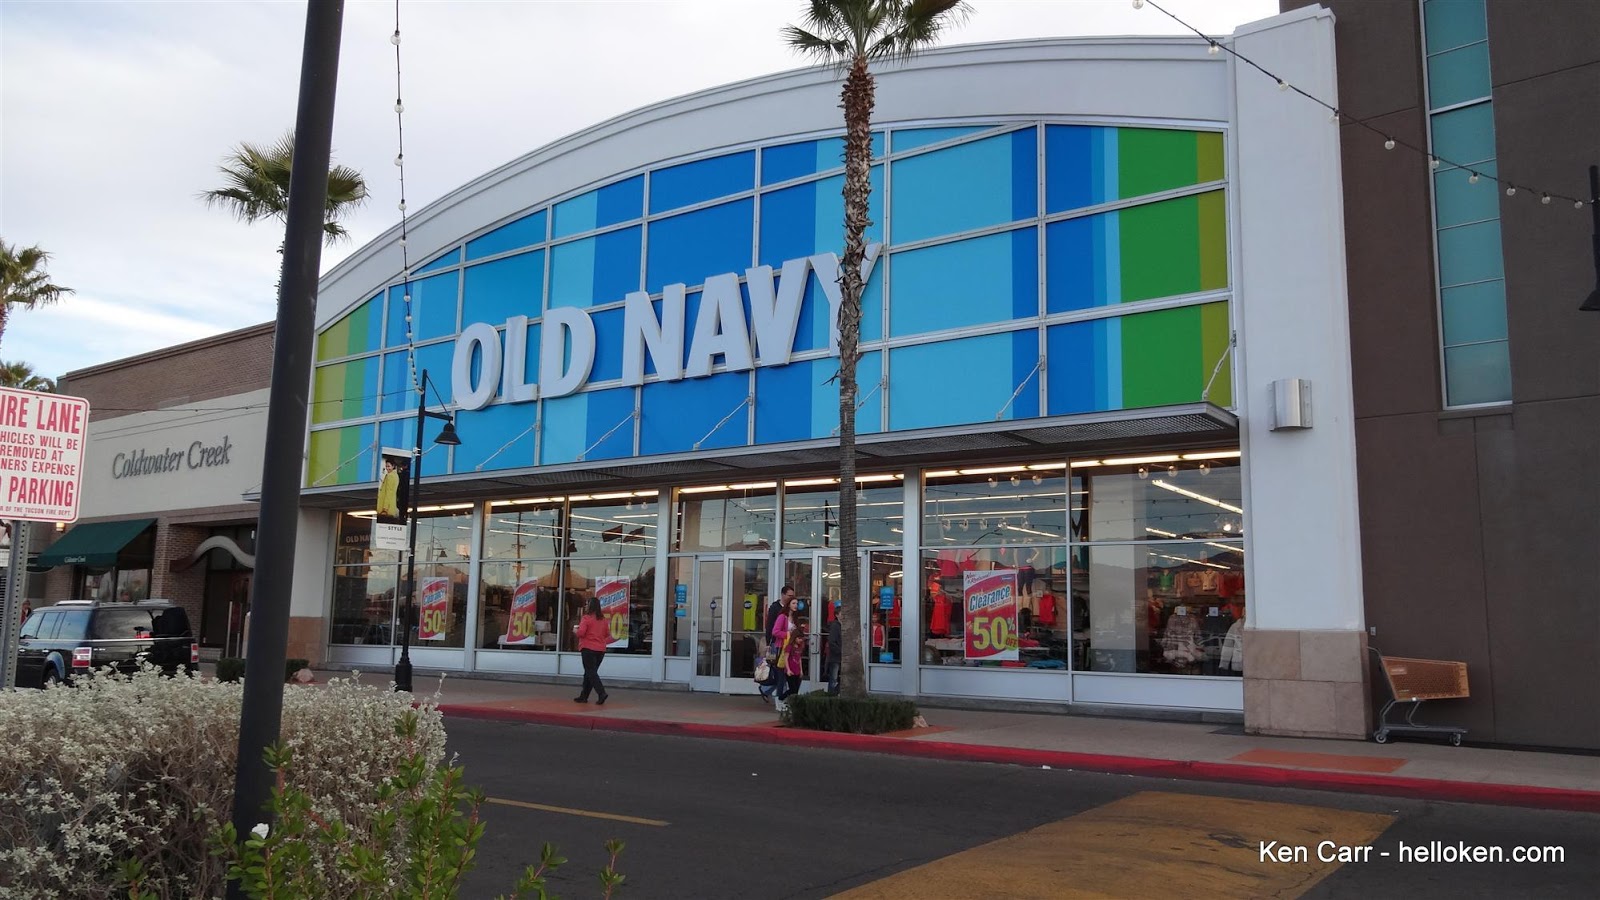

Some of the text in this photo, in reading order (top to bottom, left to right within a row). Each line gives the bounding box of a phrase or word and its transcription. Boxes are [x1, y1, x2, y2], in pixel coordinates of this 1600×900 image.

[452, 243, 882, 411] OLD NAVY
[36, 399, 82, 435] LANE
[40, 435, 62, 449] WILL
[66, 438, 78, 451] BE
[0, 444, 64, 462] REMOVED AT
[112, 435, 232, 479] Coldwater Creek
[32, 461, 76, 477] EXPENSE
[8, 475, 74, 508] PARKING
[25, 507, 44, 515] TUCSON
[46, 508, 57, 516] FIRE
[387, 525, 403, 533] STYLE
[345, 535, 360, 544] OLD
[969, 585, 1011, 612] Clearance
